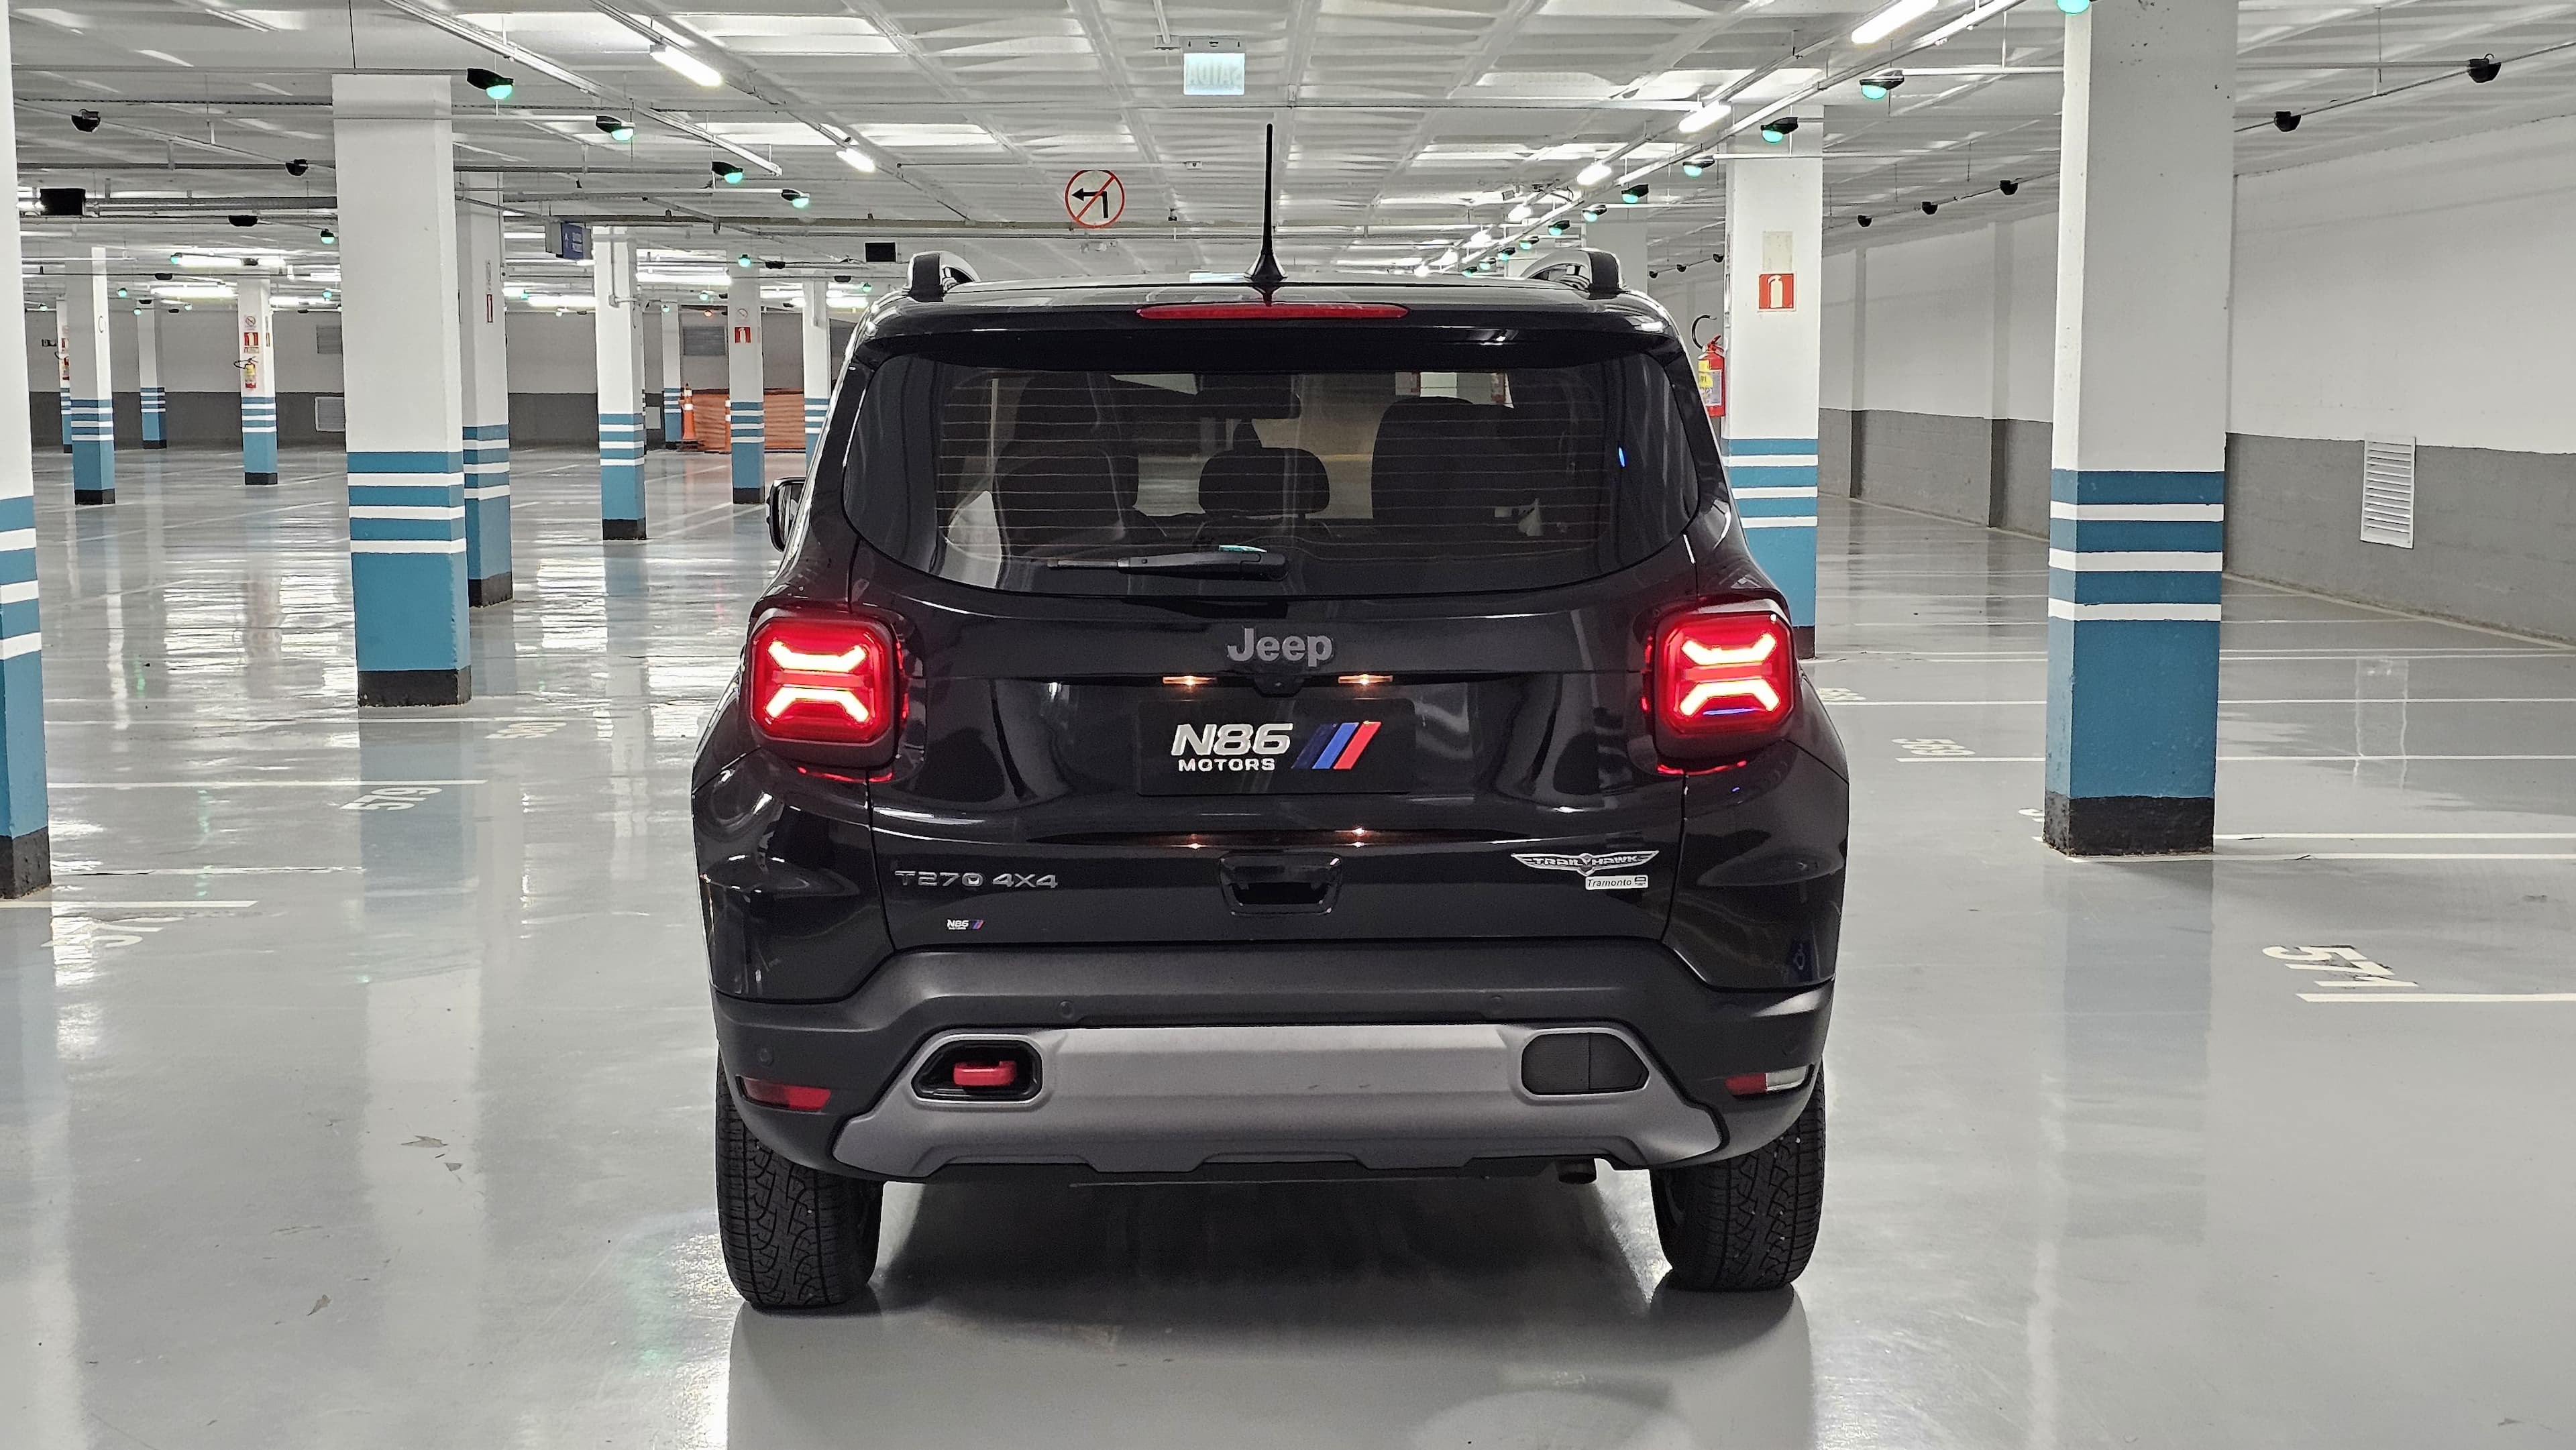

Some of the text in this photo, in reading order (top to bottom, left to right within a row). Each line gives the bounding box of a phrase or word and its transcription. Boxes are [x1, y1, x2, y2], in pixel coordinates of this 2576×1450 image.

[1228, 628, 1332, 667] Jeep
[1172, 723, 1293, 755] N86
[1179, 759, 1275, 771] MOTORS
[339, 787, 442, 811] 579
[895, 871, 983, 887] T270
[1588, 879, 1632, 887] Tramonto
[947, 919, 969, 928] N86
[2262, 946, 2419, 987] 571
